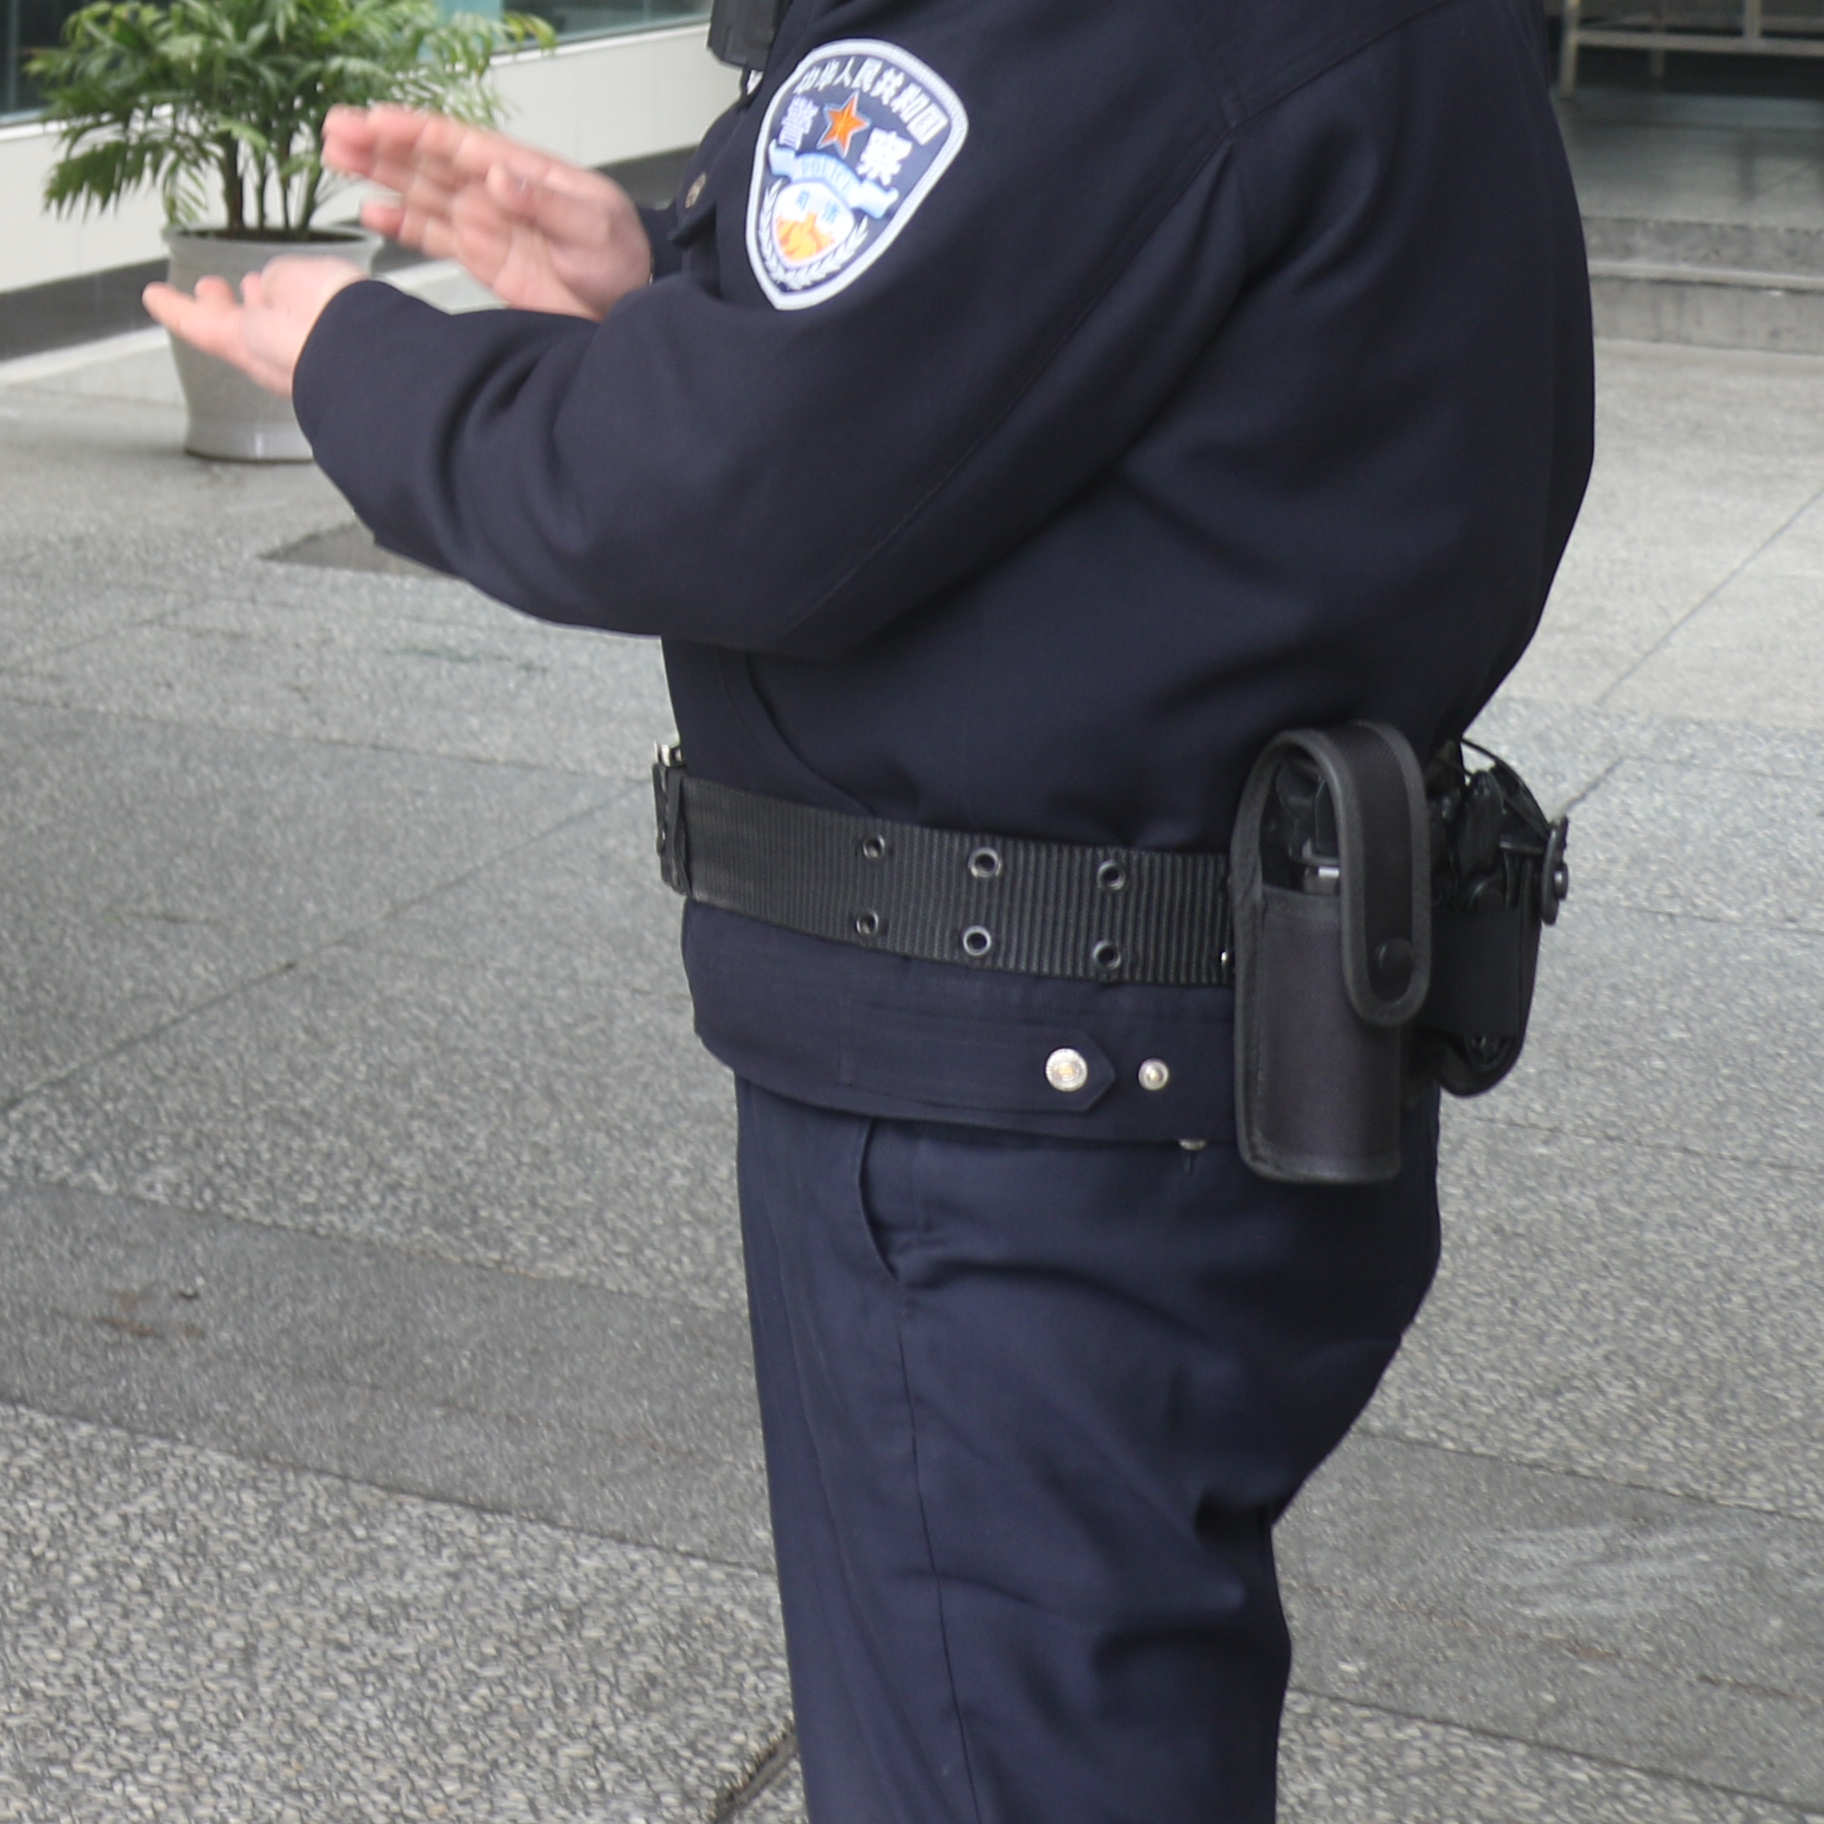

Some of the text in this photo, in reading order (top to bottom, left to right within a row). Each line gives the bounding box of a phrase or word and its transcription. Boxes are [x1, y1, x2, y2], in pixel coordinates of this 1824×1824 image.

[793, 57, 949, 146] 中华人民共和国
